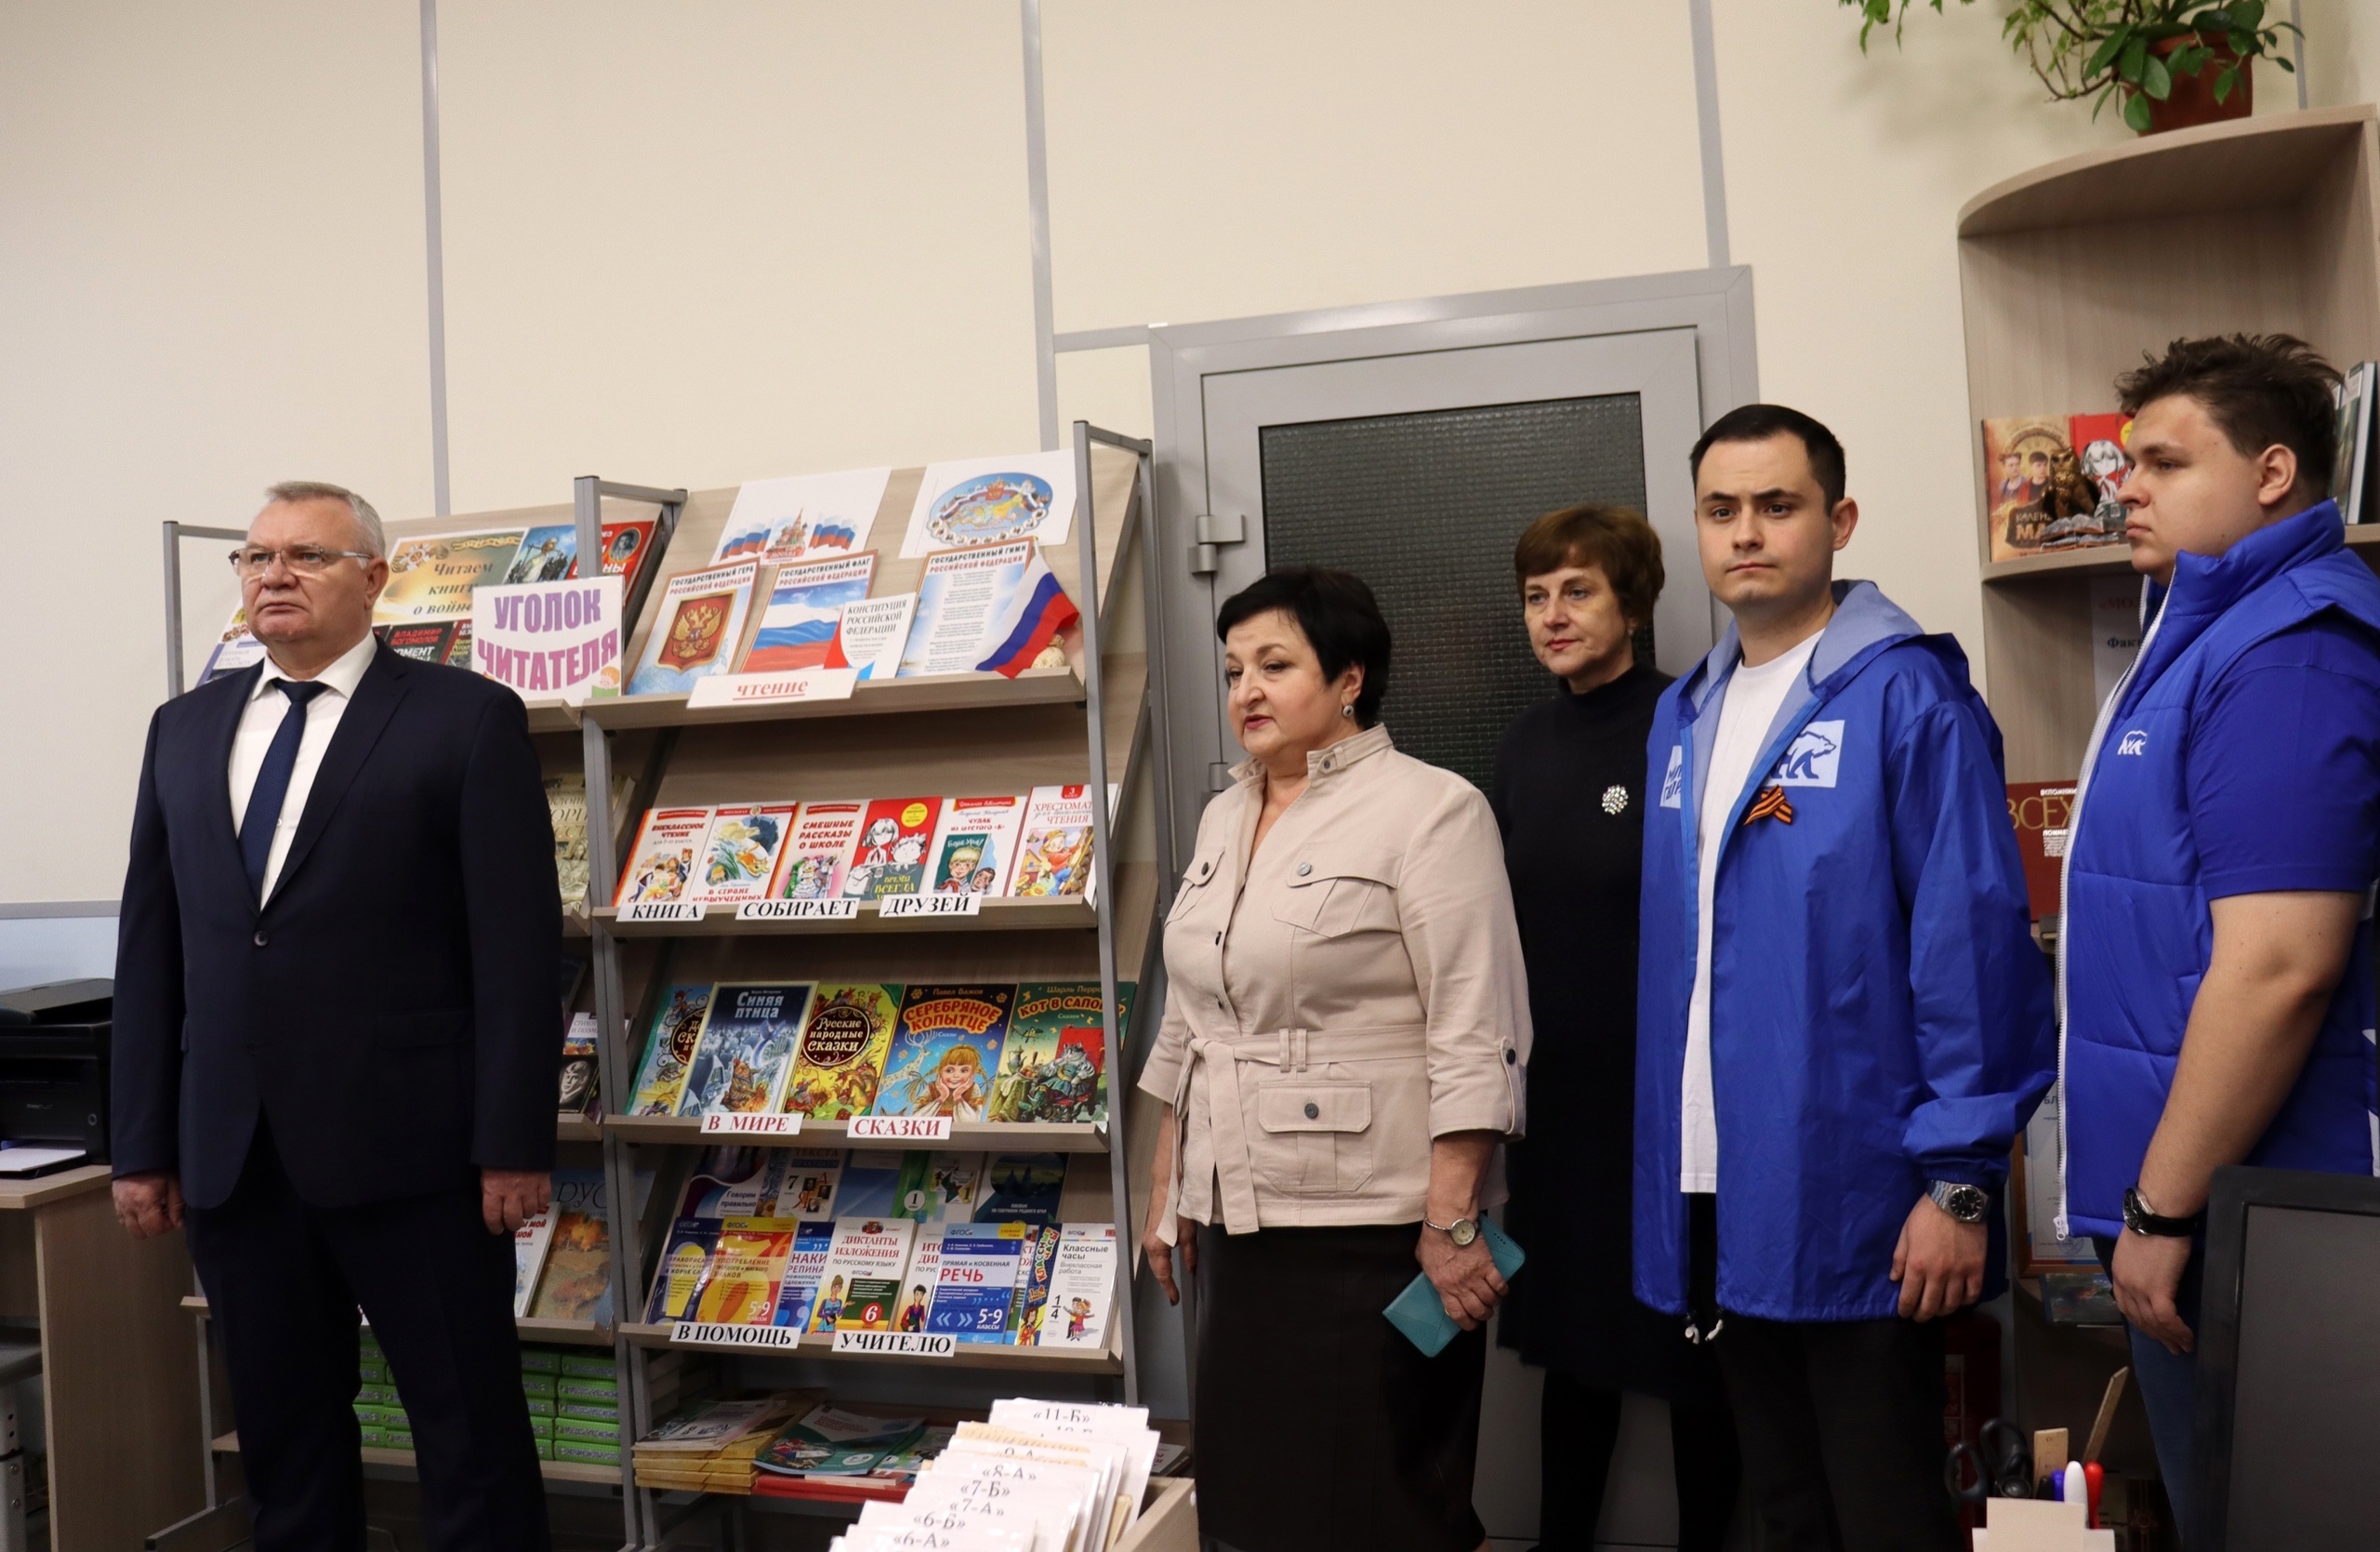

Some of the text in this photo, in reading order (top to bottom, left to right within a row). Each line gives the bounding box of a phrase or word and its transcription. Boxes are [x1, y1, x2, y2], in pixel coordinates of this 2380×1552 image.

[2016, 512, 2053, 522] КАЛЕН
[2016, 524, 2046, 540] МА
[930, 544, 1026, 564] ГОСУДАРСТВЕННЫЙ ГИМН
[434, 562, 494, 577] Читаем
[780, 559, 871, 577] ГОСУДАРСТВЕННЫЙ ФЛАГ
[930, 554, 1024, 573] РОССИЙСКОЙ ФЕДЕРАЦИИ
[670, 565, 754, 587] ГОСУДАРСТВЕННЫЙ ГЕРБ
[778, 568, 867, 586] РОССИЙСКОЙ ФЕДЕРАЦИИ
[669, 576, 751, 595] РОССИЙСКОЙ ФЕДЕРАЦИИ
[495, 589, 602, 633] УГОЛОК
[847, 600, 907, 615] КОНСТИТУЦИЯ
[846, 611, 903, 625] РОССИЙСКОЙ
[394, 628, 443, 639] ВЛАДИМИР
[846, 624, 896, 635] ФЕДЕРАЦИИ
[390, 636, 439, 646] БОГОМОЛОВ
[2107, 637, 2142, 648] Фак
[478, 628, 617, 691] ЧИТАТЕЛЯ
[737, 681, 809, 696] чтение
[1034, 802, 1092, 812] ХРЕСТОМАТ
[802, 820, 855, 829] СМЕШНЫЕ
[1047, 816, 1089, 824] ЧТЕНИЯ
[652, 823, 706, 831] ВНЕКЛАССНОЕ
[661, 830, 691, 839] ЧТЕНИЕ
[799, 830, 853, 840] РАССКАЗЫ
[874, 883, 915, 894] ВСЕГДА
[631, 904, 699, 919] КНИГА
[743, 900, 856, 918] СОБИРАЕТ
[884, 893, 970, 916] ДРУЗЕЙ
[932, 988, 984, 996] Павел Бажов
[1047, 986, 1075, 994] Шарль
[736, 991, 785, 1006] Синяя
[734, 1006, 779, 1019] птица
[905, 1001, 1001, 1021] СЕРЕБРЯНОЕ
[1019, 1000, 1050, 1017] КОТ
[1051, 1000, 1062, 1009] В
[816, 1017, 862, 1030] Русские
[910, 1015, 987, 1033] КОПЫТЦЕ
[810, 1029, 864, 1040] народные
[707, 1116, 942, 1137] В МИРЕ СКАЗКИ
[788, 1175, 799, 1189] 7
[726, 1190, 756, 1199] Говорим
[912, 1193, 919, 1204] 1
[721, 1200, 757, 1208] правильно
[529, 1219, 547, 1228] МОЙ
[841, 1235, 898, 1246] ДИКТАНТЫ
[835, 1247, 900, 1258] ИЗЛОЖЕНИЯ
[1063, 1243, 1109, 1253] Классные
[668, 1255, 707, 1264] ПРАВОПИСА
[1060, 1261, 1103, 1269] Внеклассная
[940, 1268, 984, 1282] РЕЧЬ
[1055, 1294, 1061, 1306] 1
[749, 1301, 772, 1317] 5-9
[866, 1305, 878, 1322] 6
[1051, 1308, 1059, 1320] 4
[978, 1308, 1003, 1325] 5-9
[677, 1324, 952, 1354] В ПОМОЩЬ УЧИТЕЛЮ
[1034, 1407, 1091, 1424] «11-Б»
[960, 1479, 1011, 1498] «7-Б»
